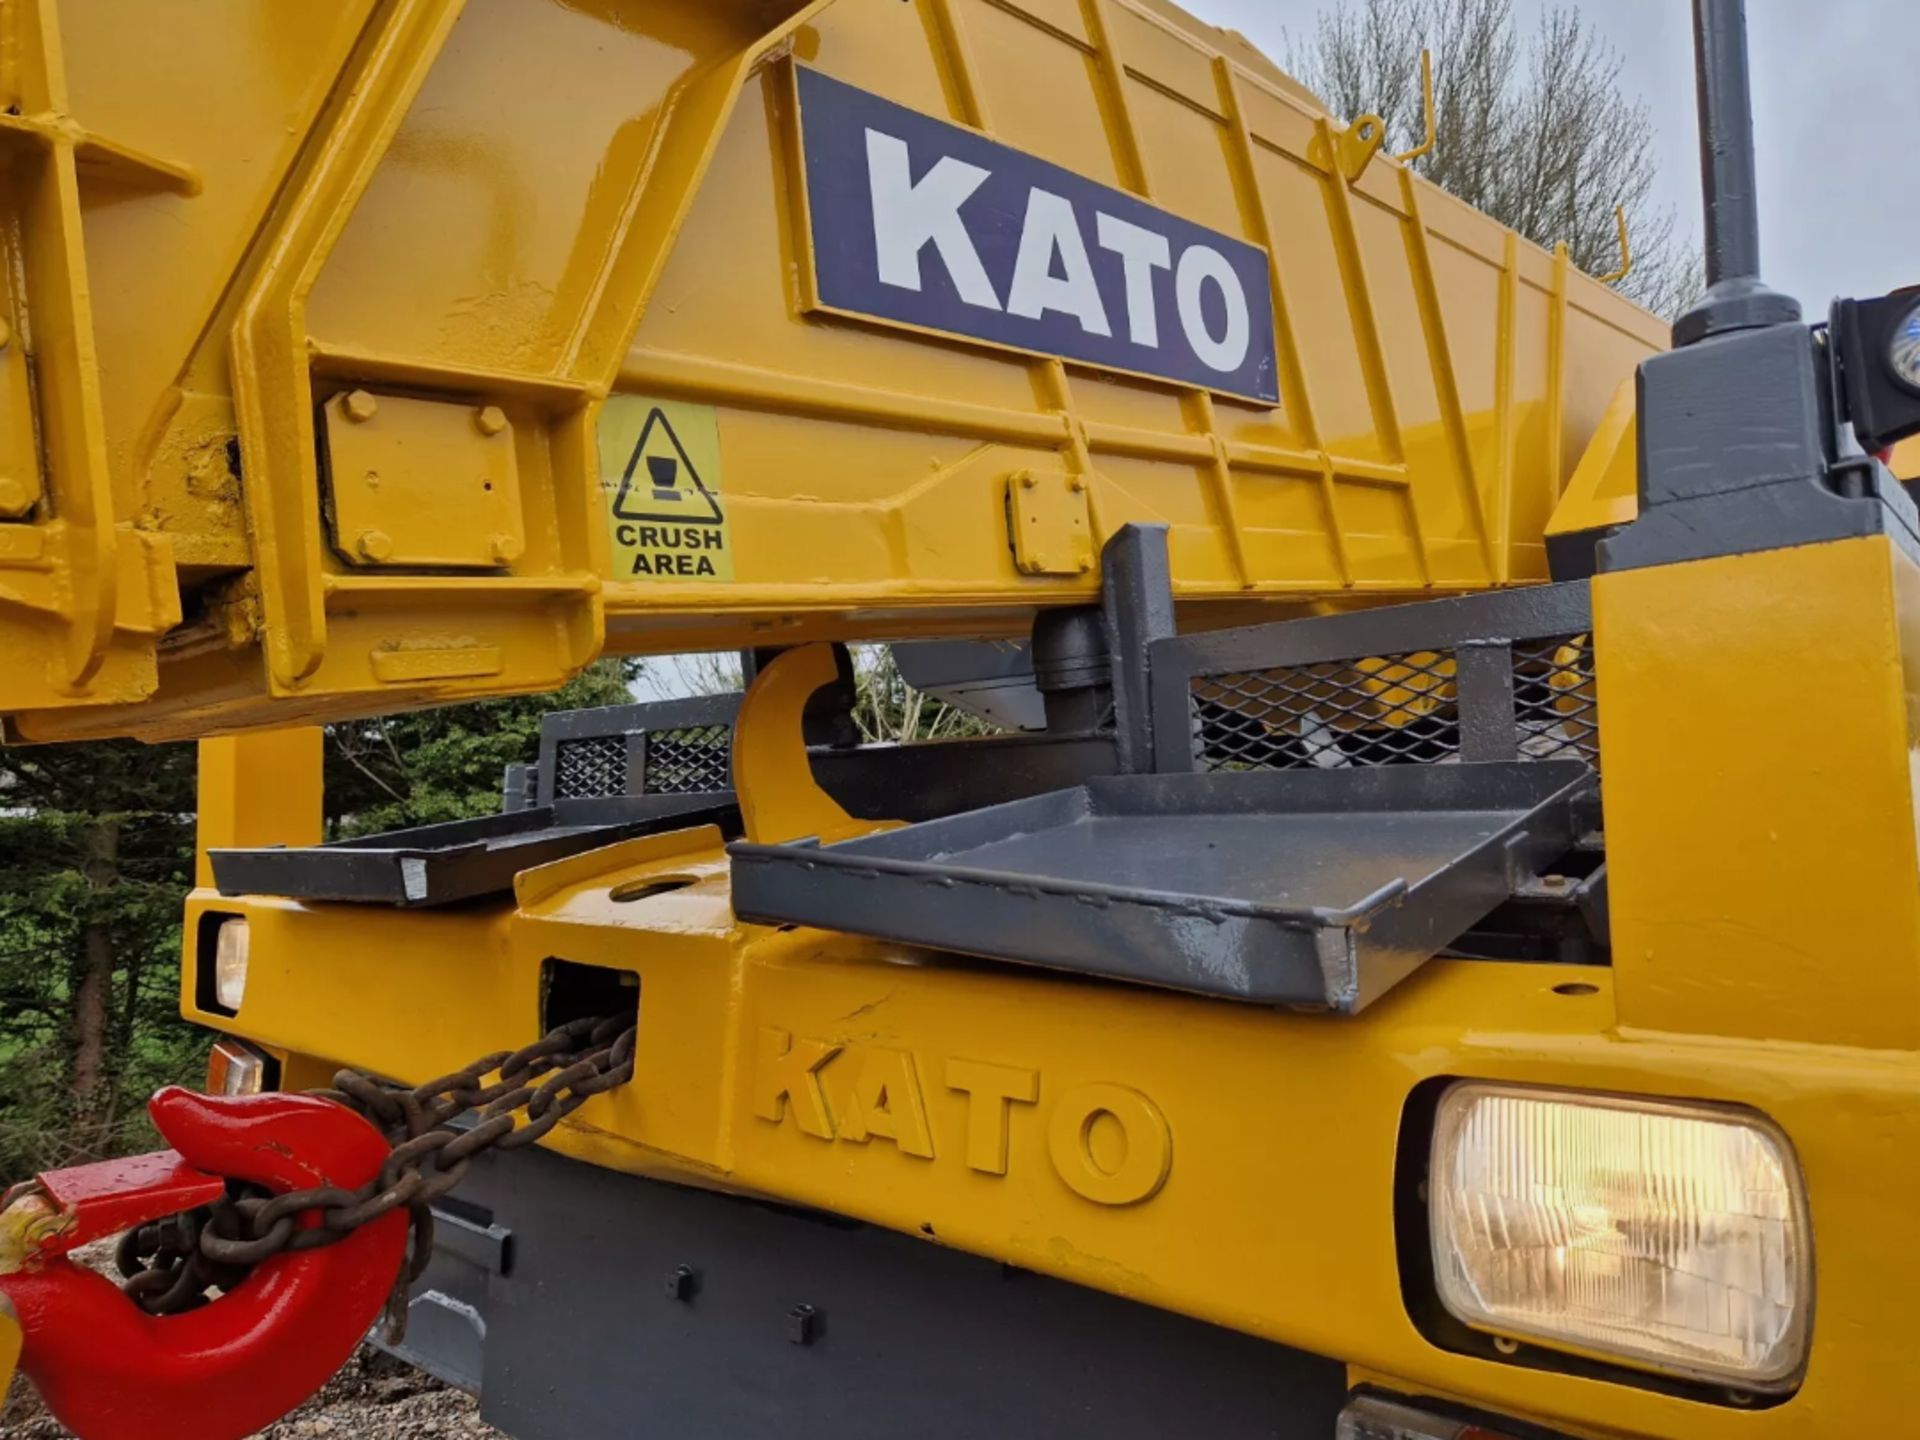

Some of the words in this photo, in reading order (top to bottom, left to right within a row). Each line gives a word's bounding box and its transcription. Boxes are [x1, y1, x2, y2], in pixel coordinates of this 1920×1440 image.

[865, 127, 1250, 372] KATO
[615, 524, 723, 550] CRUSH
[631, 553, 716, 576] AREA
[753, 1025, 1173, 1206] KATO
